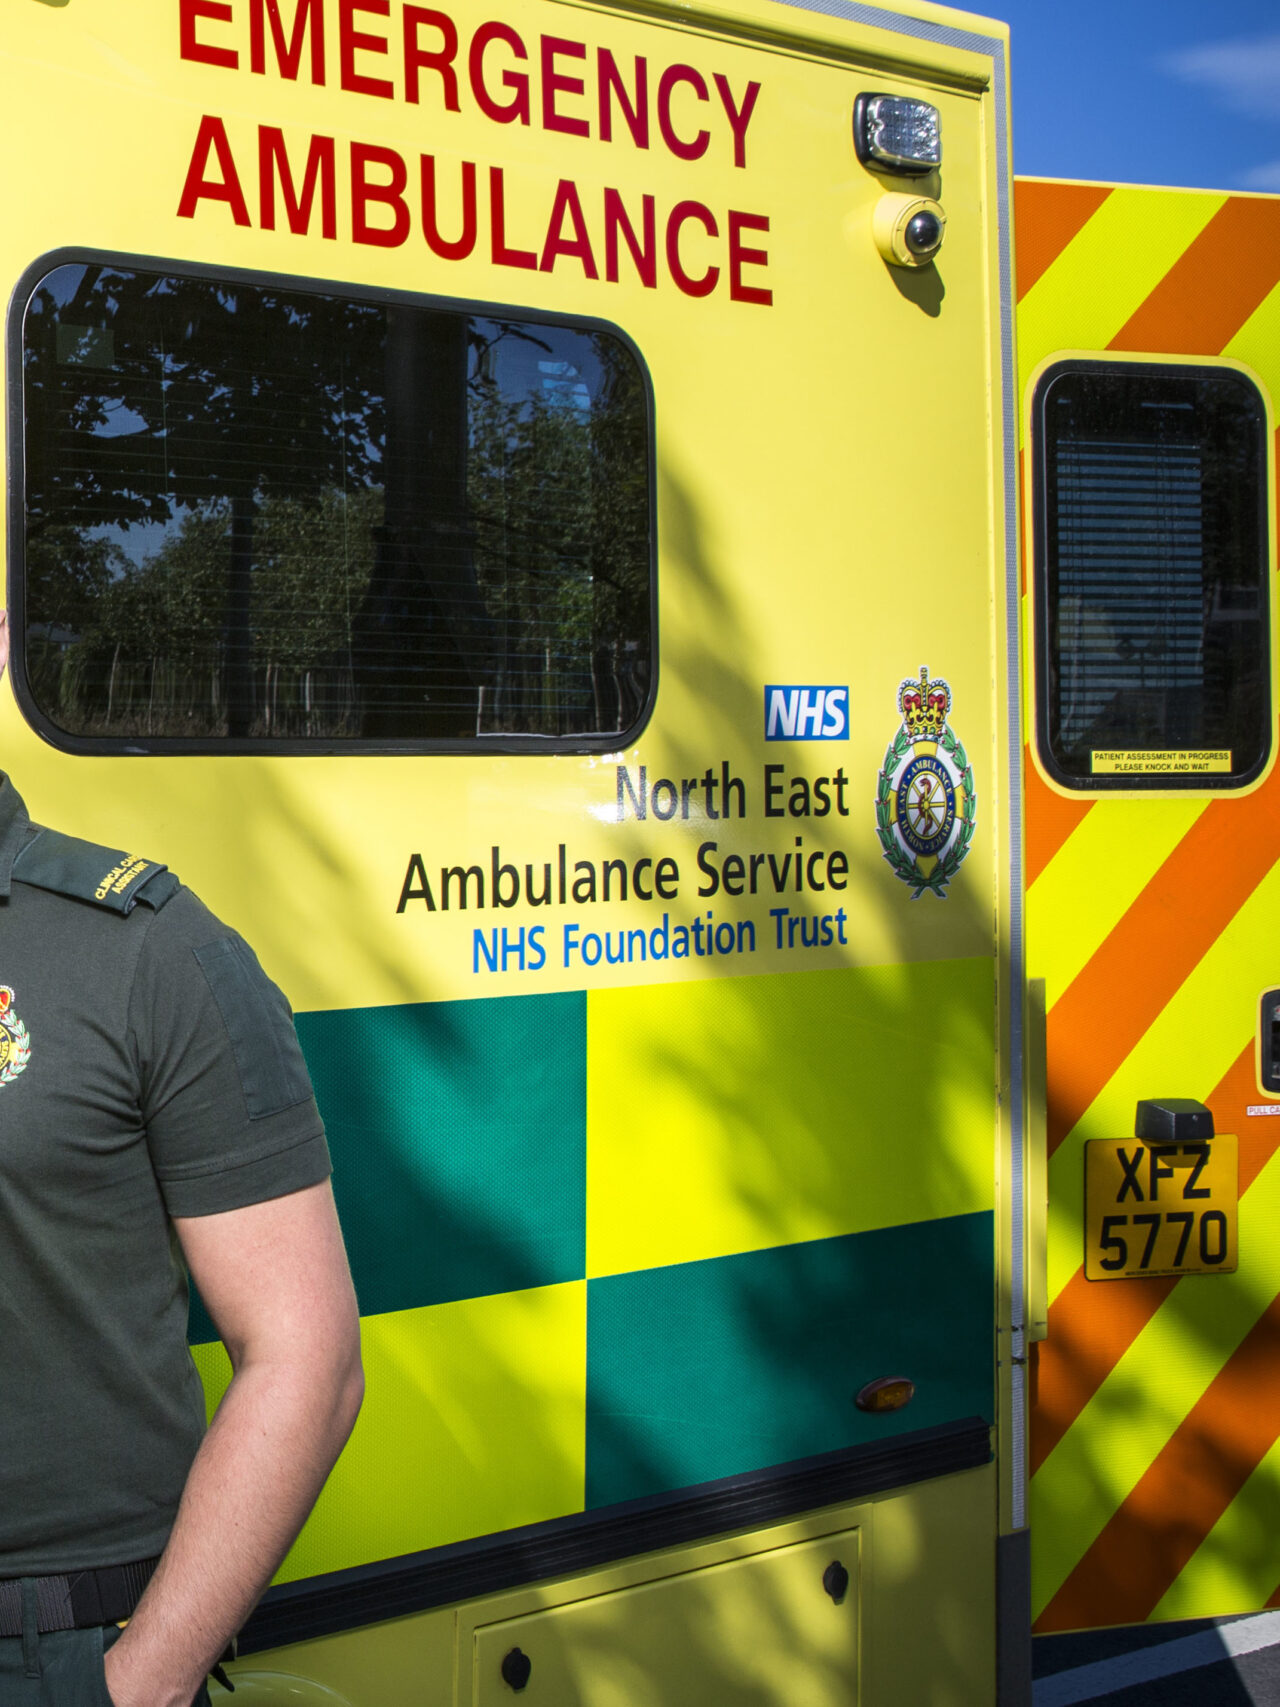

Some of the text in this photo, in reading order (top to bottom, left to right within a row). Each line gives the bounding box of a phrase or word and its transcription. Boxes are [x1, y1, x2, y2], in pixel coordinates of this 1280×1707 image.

[179, 0, 761, 169] EMERGENCY
[176, 115, 773, 307] AMBULANCE
[766, 688, 847, 737] NHS
[911, 759, 953, 794] AMBULANCE
[1094, 753, 1124, 761] PATIENT
[1126, 753, 1176, 761] ASSESSMENT
[1188, 752, 1229, 760] PROGRESS
[1114, 763, 1143, 771] PLEASE
[616, 761, 849, 822] North East
[395, 836, 848, 914] Ambulance Service
[472, 906, 848, 974] NHS Foundation Trust
[1249, 1107, 1267, 1115] PULL
[1116, 1143, 1211, 1203] XFZ
[1099, 1210, 1228, 1271] 5770
